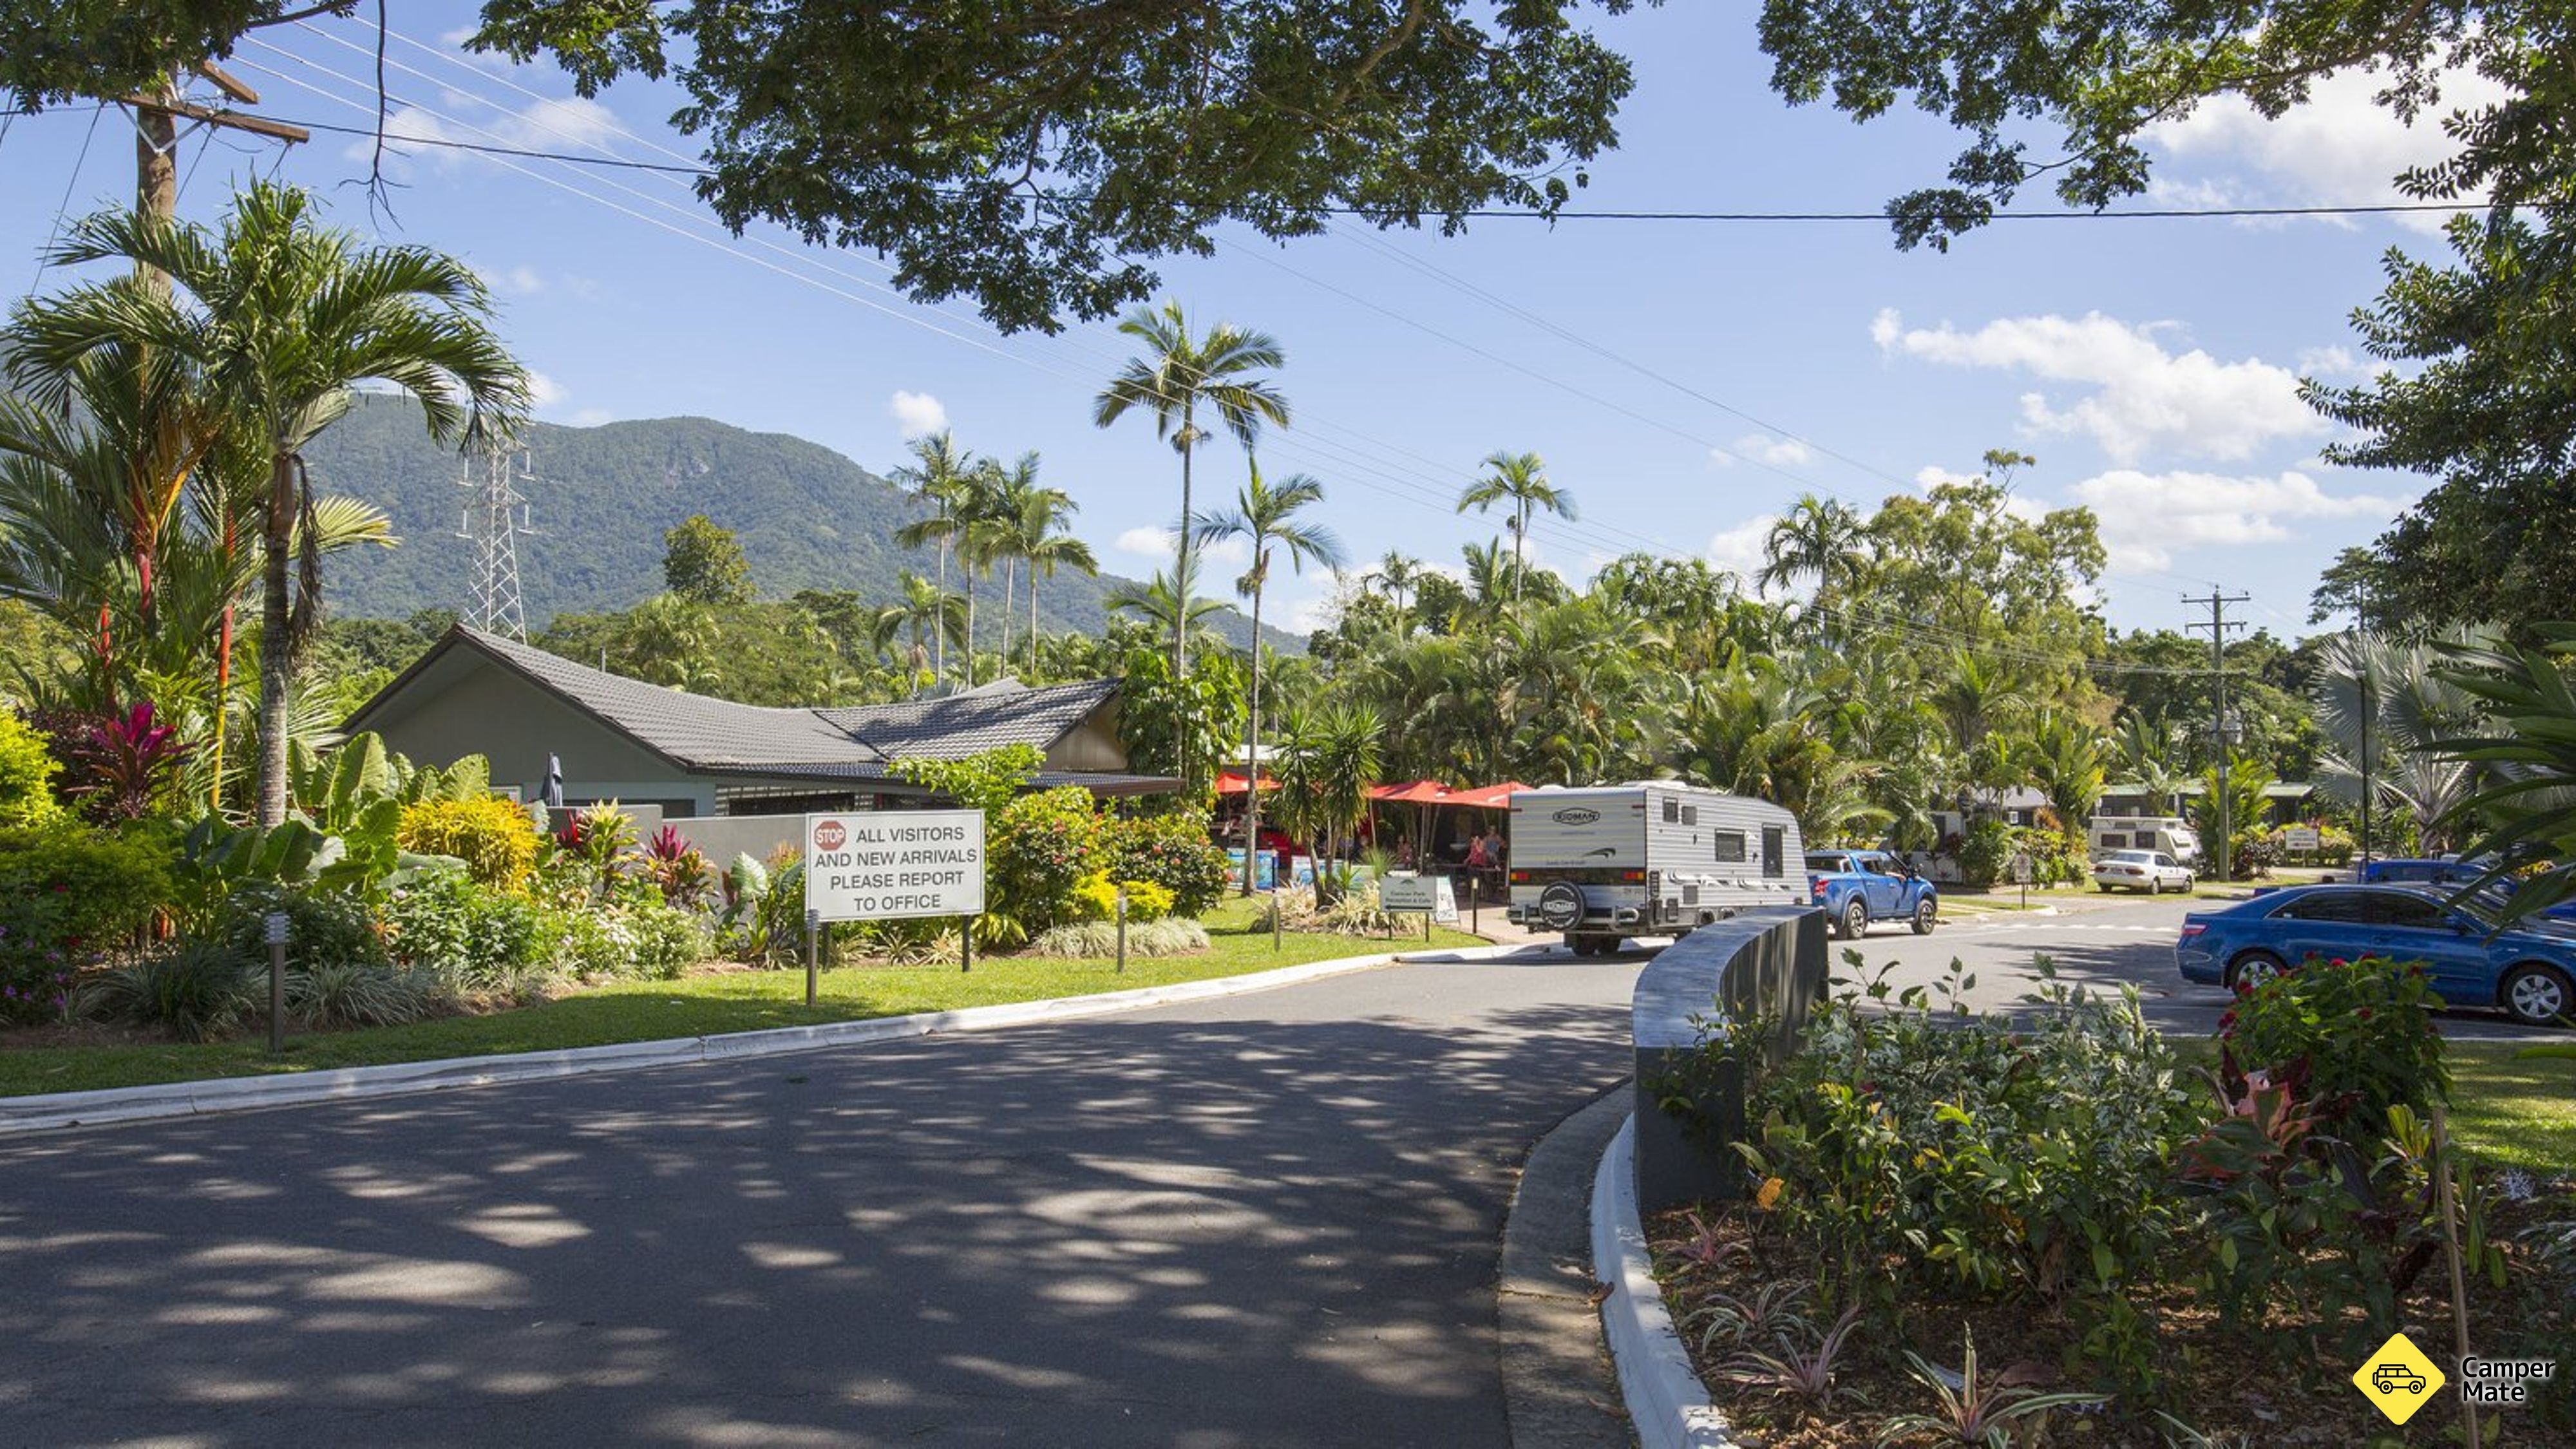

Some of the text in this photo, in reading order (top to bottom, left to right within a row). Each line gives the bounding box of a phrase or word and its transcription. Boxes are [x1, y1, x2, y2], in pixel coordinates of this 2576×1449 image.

[816, 828, 845, 844] STOP
[857, 827, 964, 843] ALL VISITORS
[815, 849, 977, 867] AND NEW ARRIVALS
[831, 871, 964, 889] PLEASE REPORT
[854, 895, 941, 911] TO OFFICE
